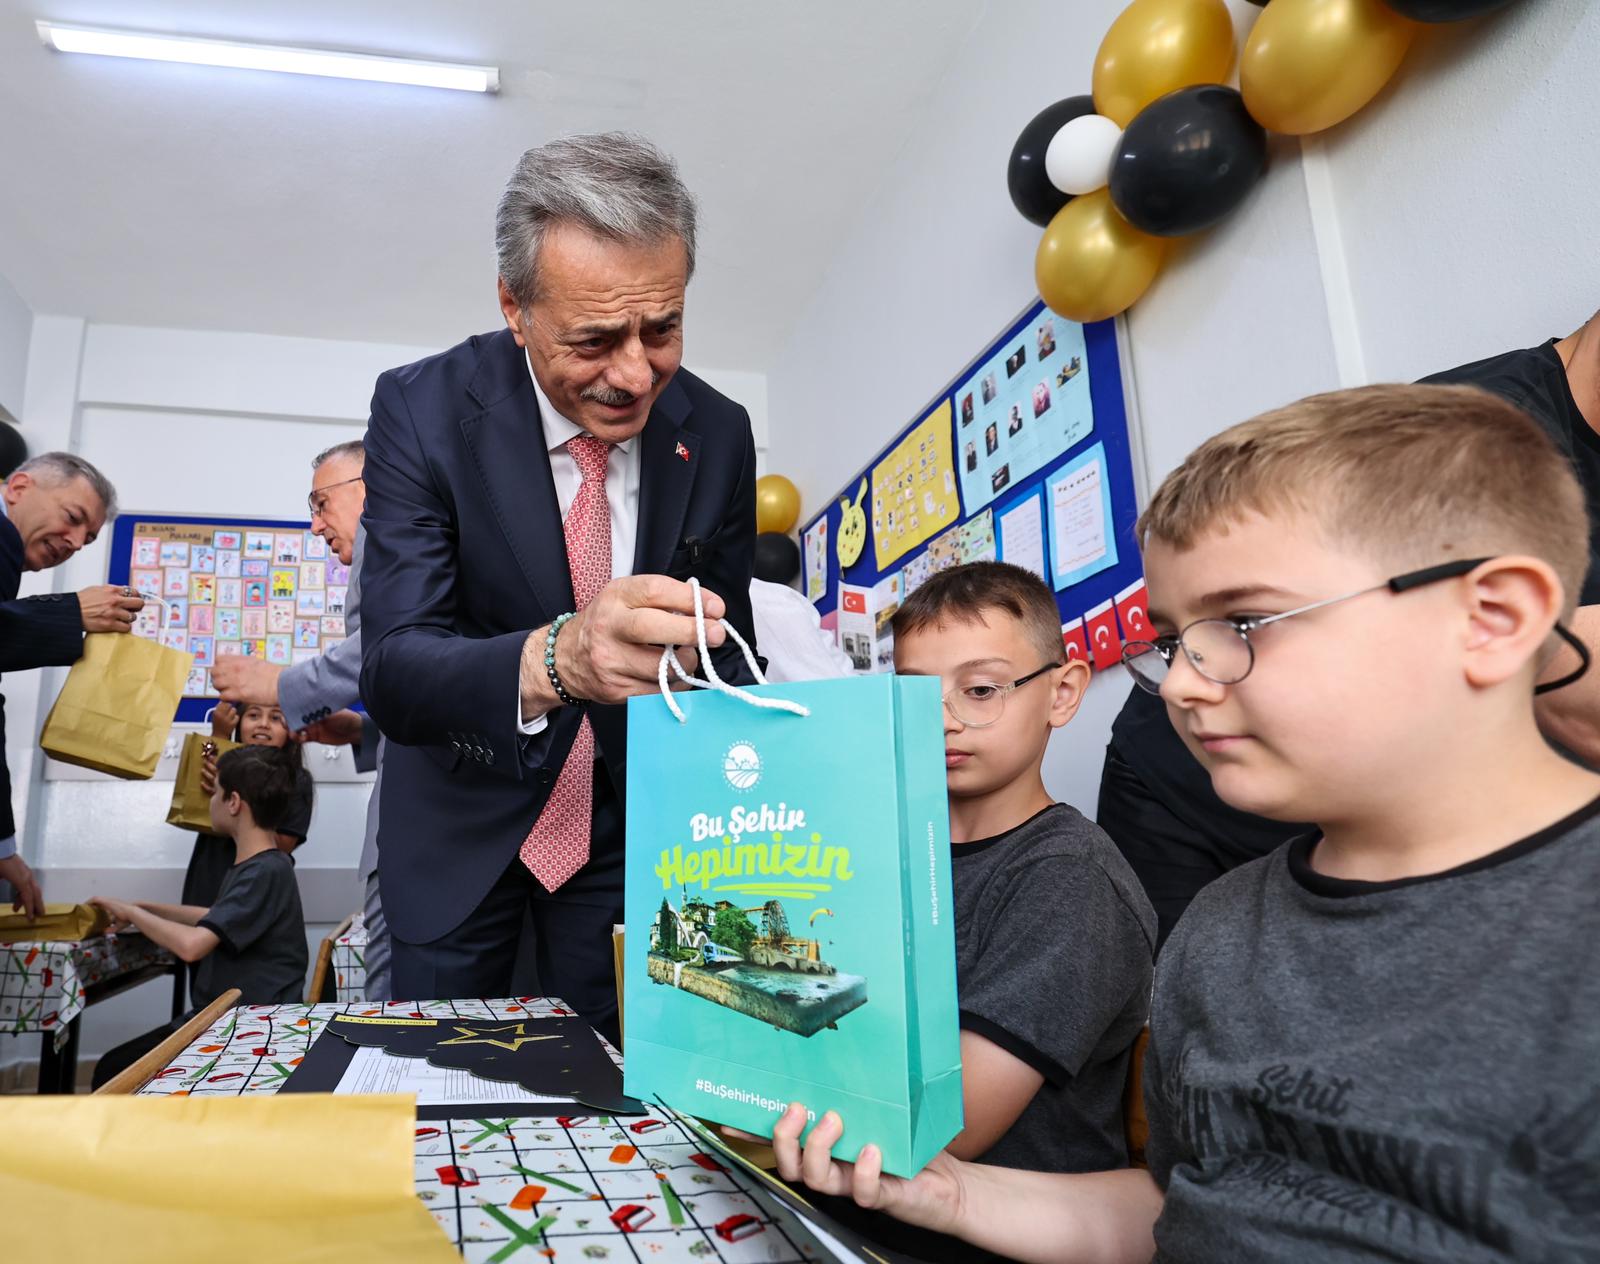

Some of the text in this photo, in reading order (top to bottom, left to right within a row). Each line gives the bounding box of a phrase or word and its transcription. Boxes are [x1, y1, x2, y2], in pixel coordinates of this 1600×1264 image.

[690, 802, 806, 844] Bu Şehir
[655, 832, 854, 890] Hepimizin
